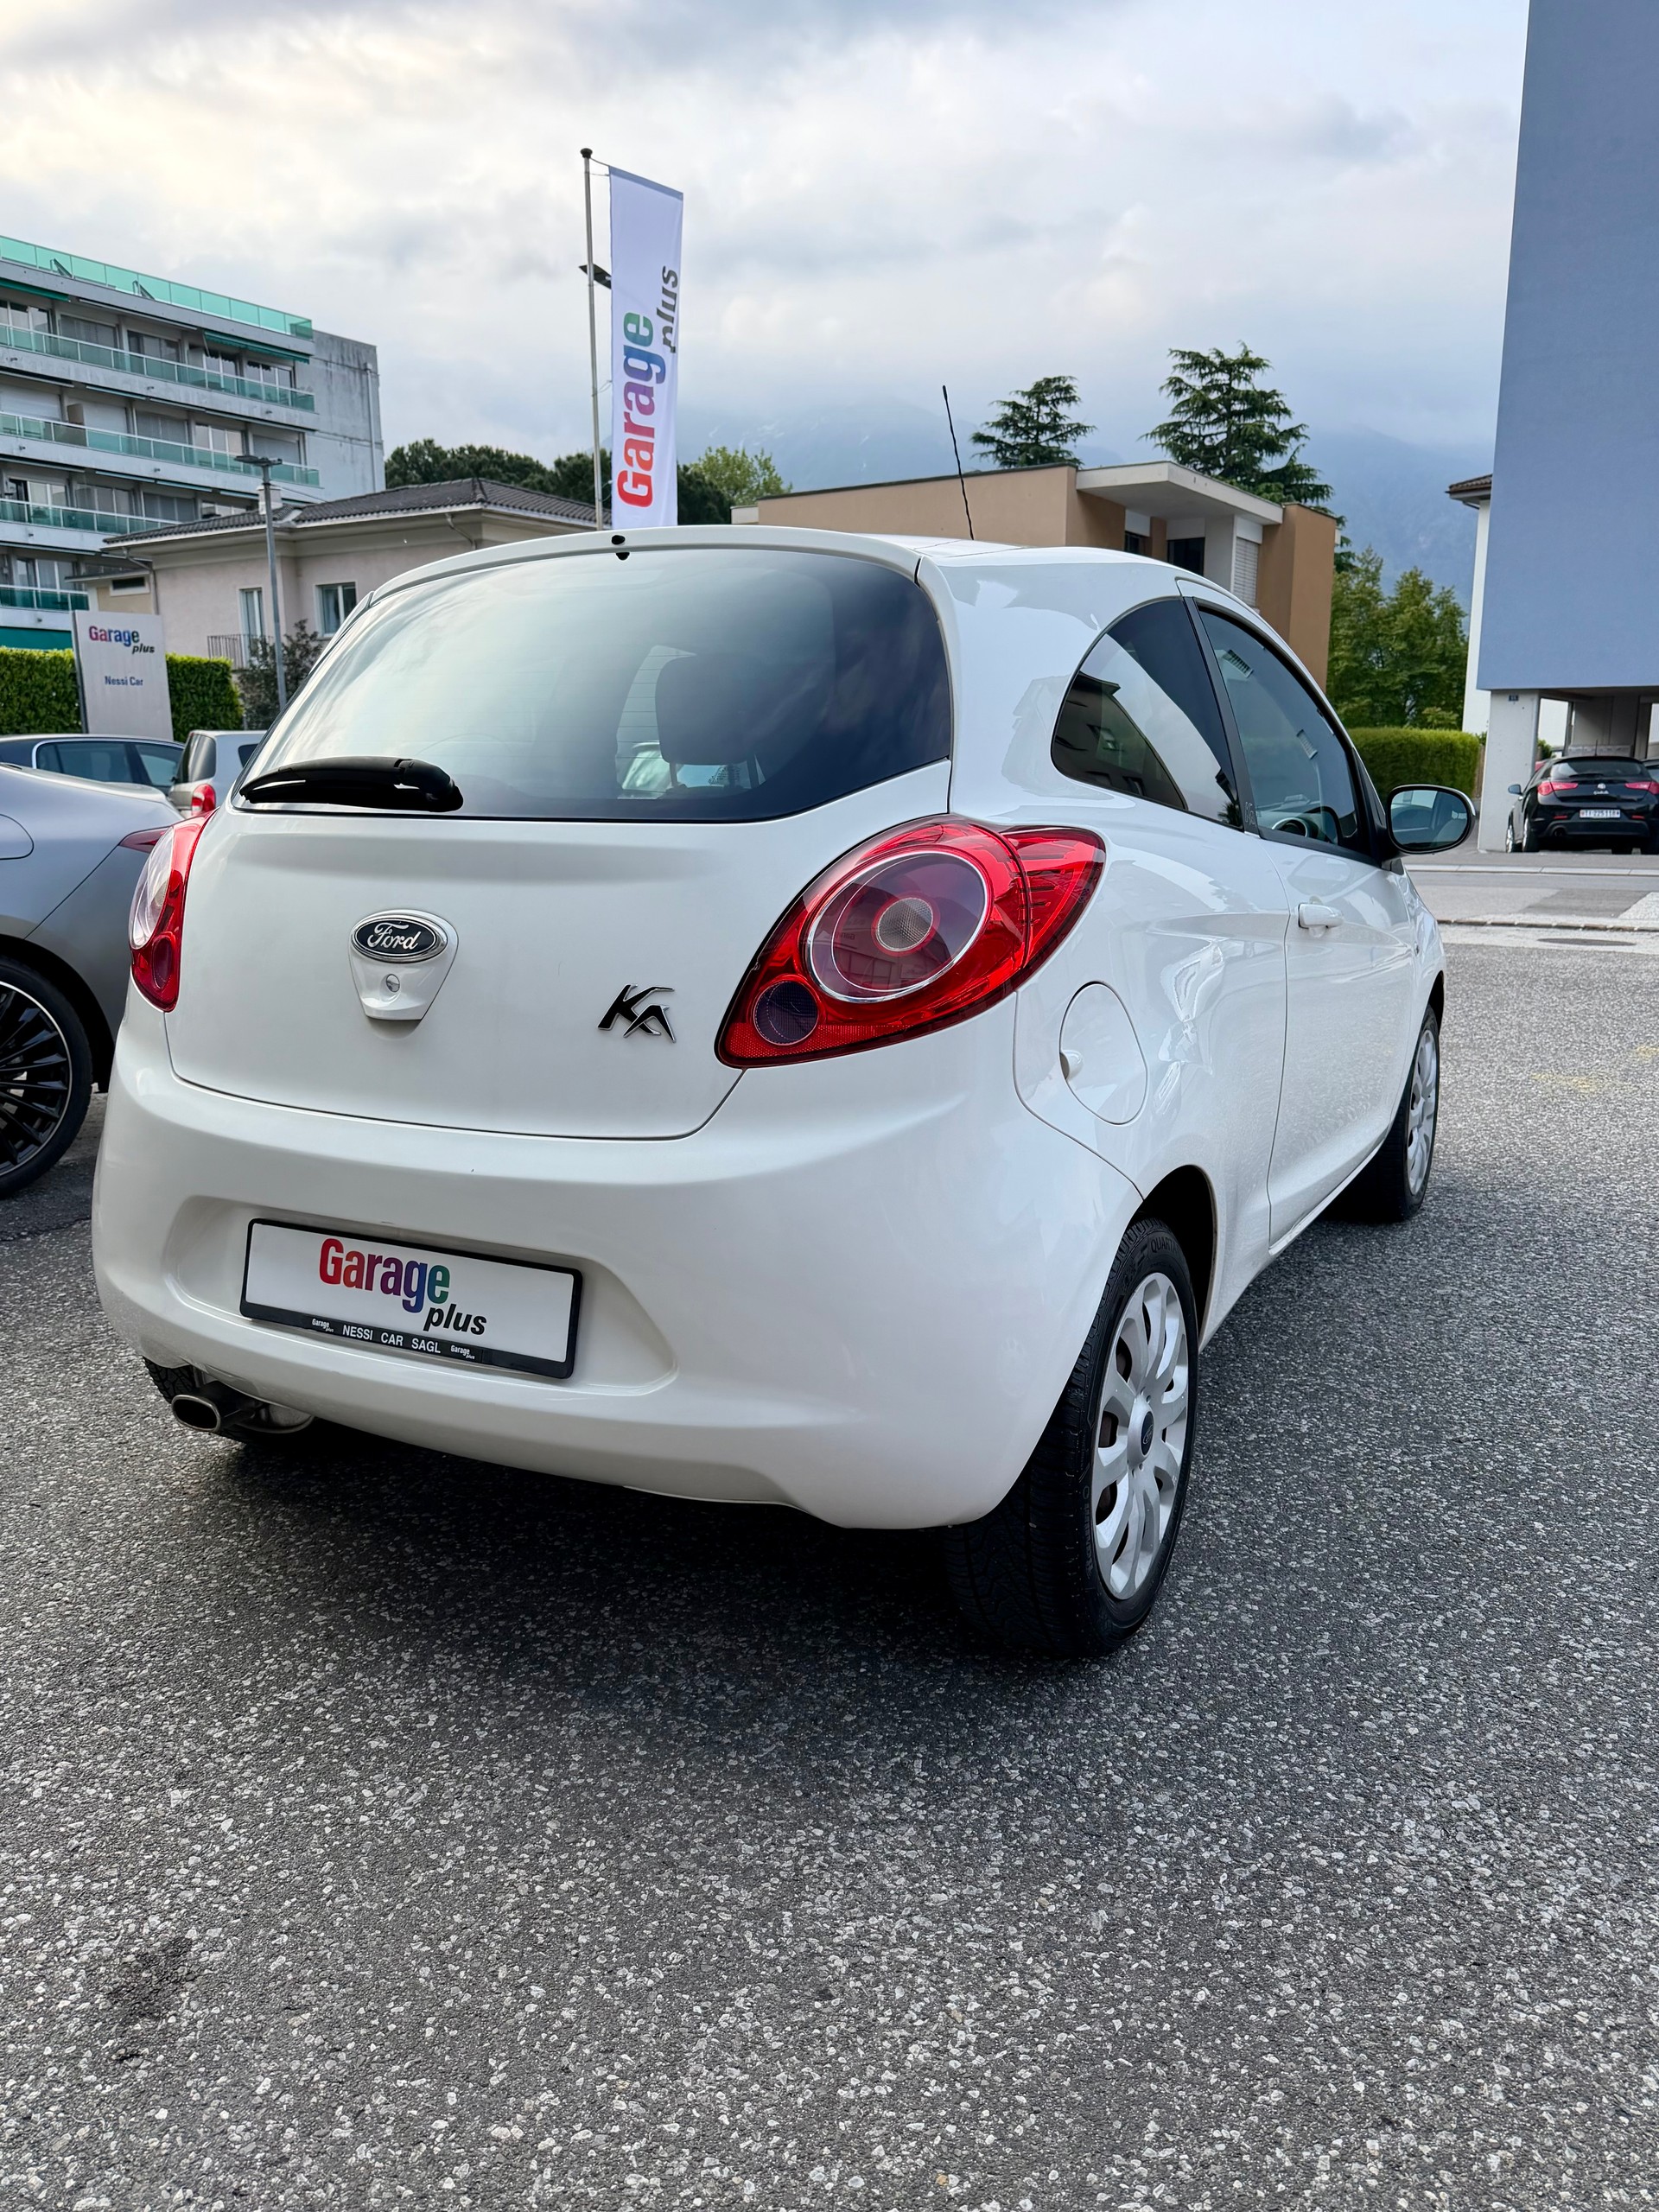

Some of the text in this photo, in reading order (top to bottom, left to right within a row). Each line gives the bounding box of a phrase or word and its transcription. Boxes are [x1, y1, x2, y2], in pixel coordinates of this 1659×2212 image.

[656, 265, 678, 353] plus
[617, 312, 665, 508] Garage
[89, 626, 140, 647] Garage
[131, 644, 155, 654] plus
[105, 676, 143, 686] Nessi Car
[367, 922, 422, 950] Ford
[319, 1237, 450, 1313] Garage
[312, 1318, 329, 1329] Garage
[423, 1303, 487, 1335] plus
[342, 1325, 442, 1353] NESSI CAR SAGL
[450, 1344, 470, 1356] Garage
